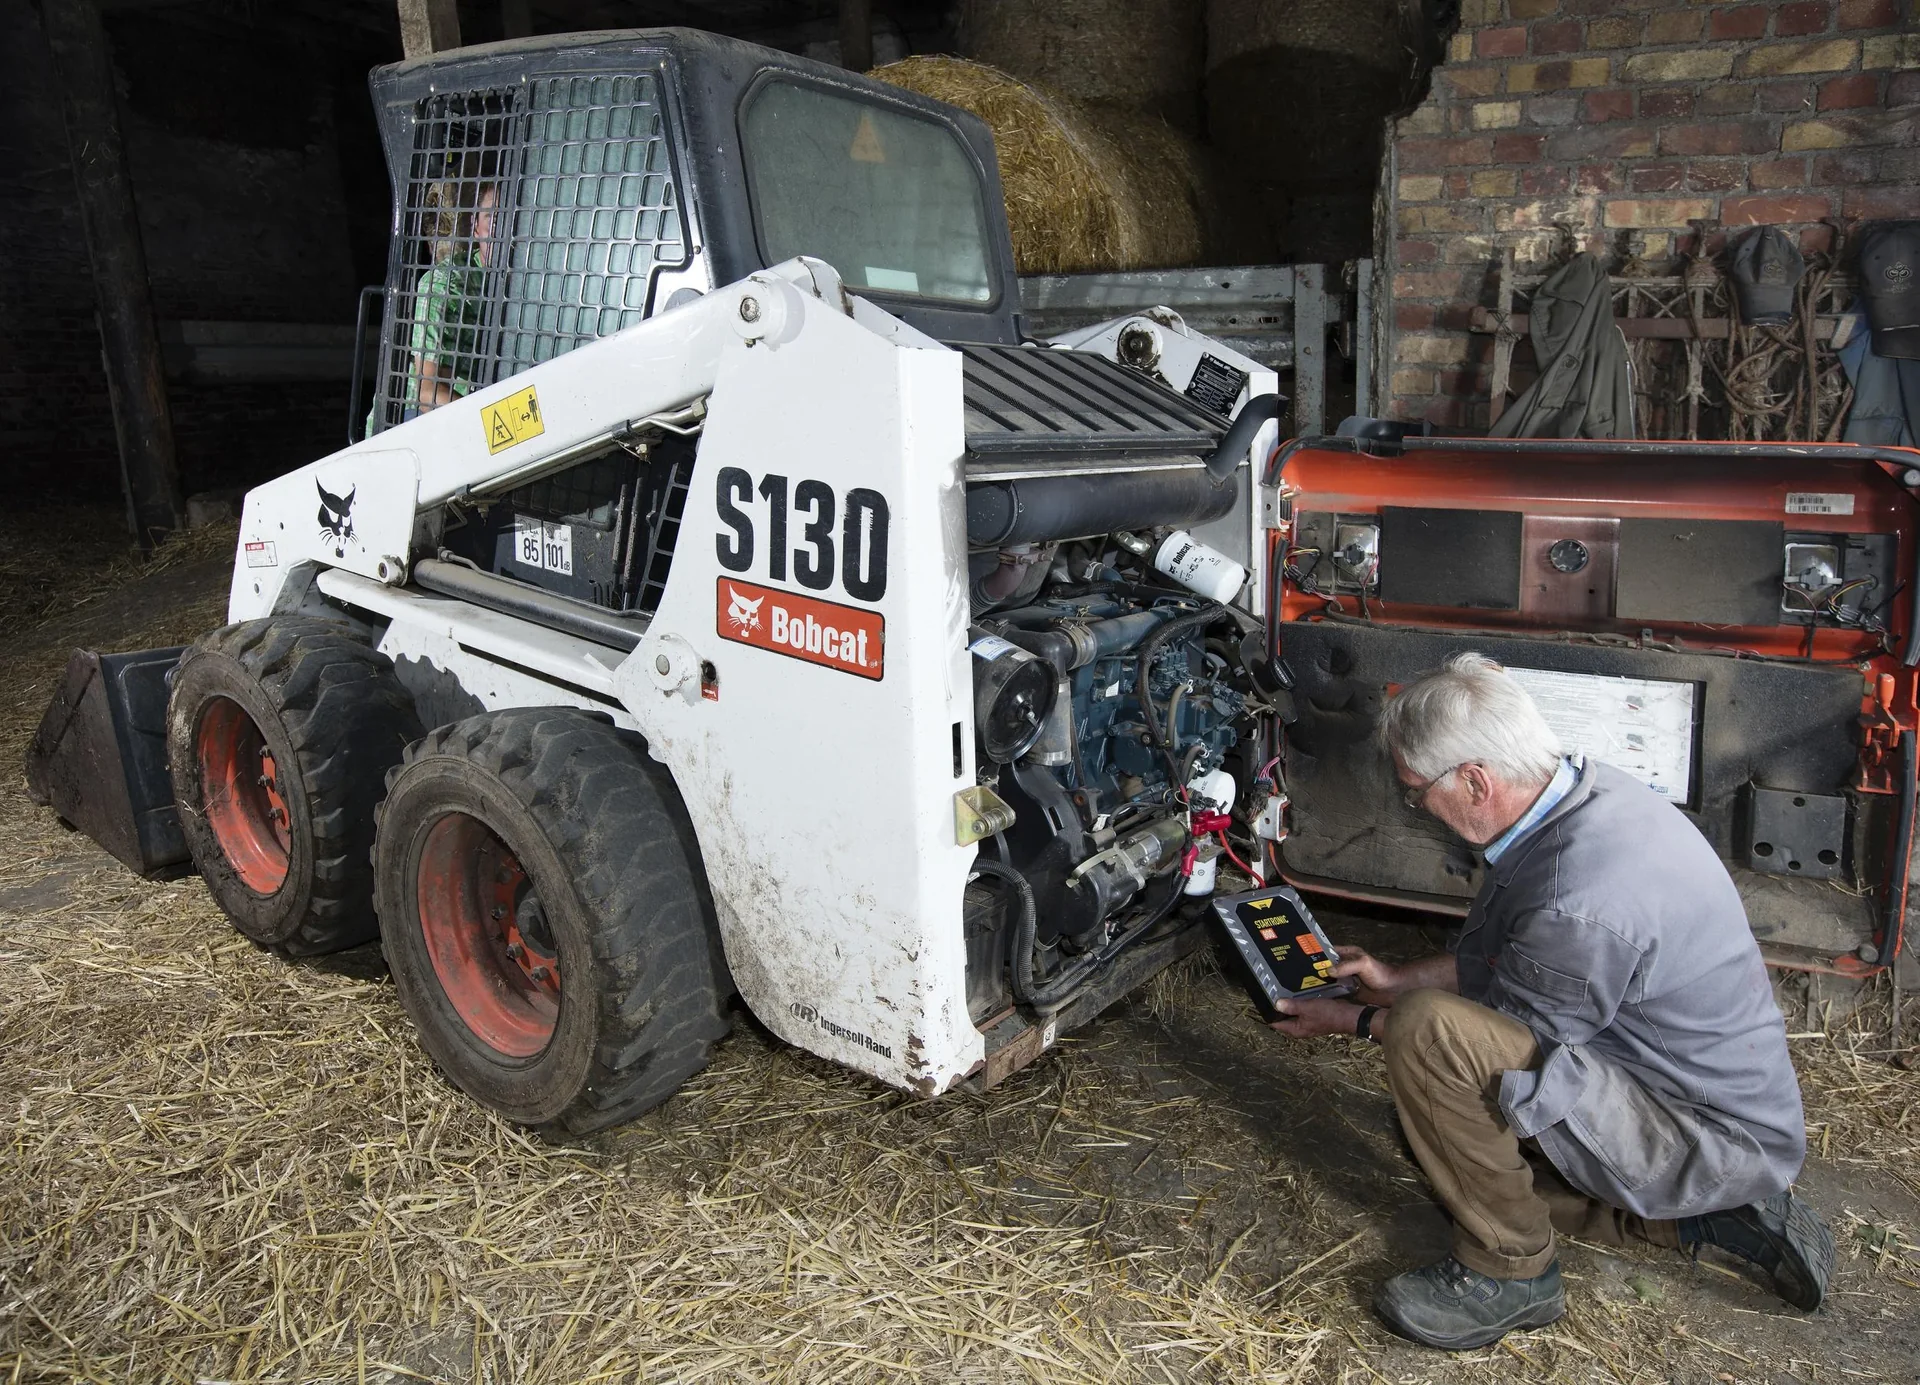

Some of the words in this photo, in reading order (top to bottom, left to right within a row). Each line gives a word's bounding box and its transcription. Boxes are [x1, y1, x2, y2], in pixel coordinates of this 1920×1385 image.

[716, 466, 890, 602] S130
[523, 537, 539, 563] 85
[545, 543, 564, 570] 101
[1172, 542, 1193, 565] Bobcat
[771, 605, 868, 667] Bobcat
